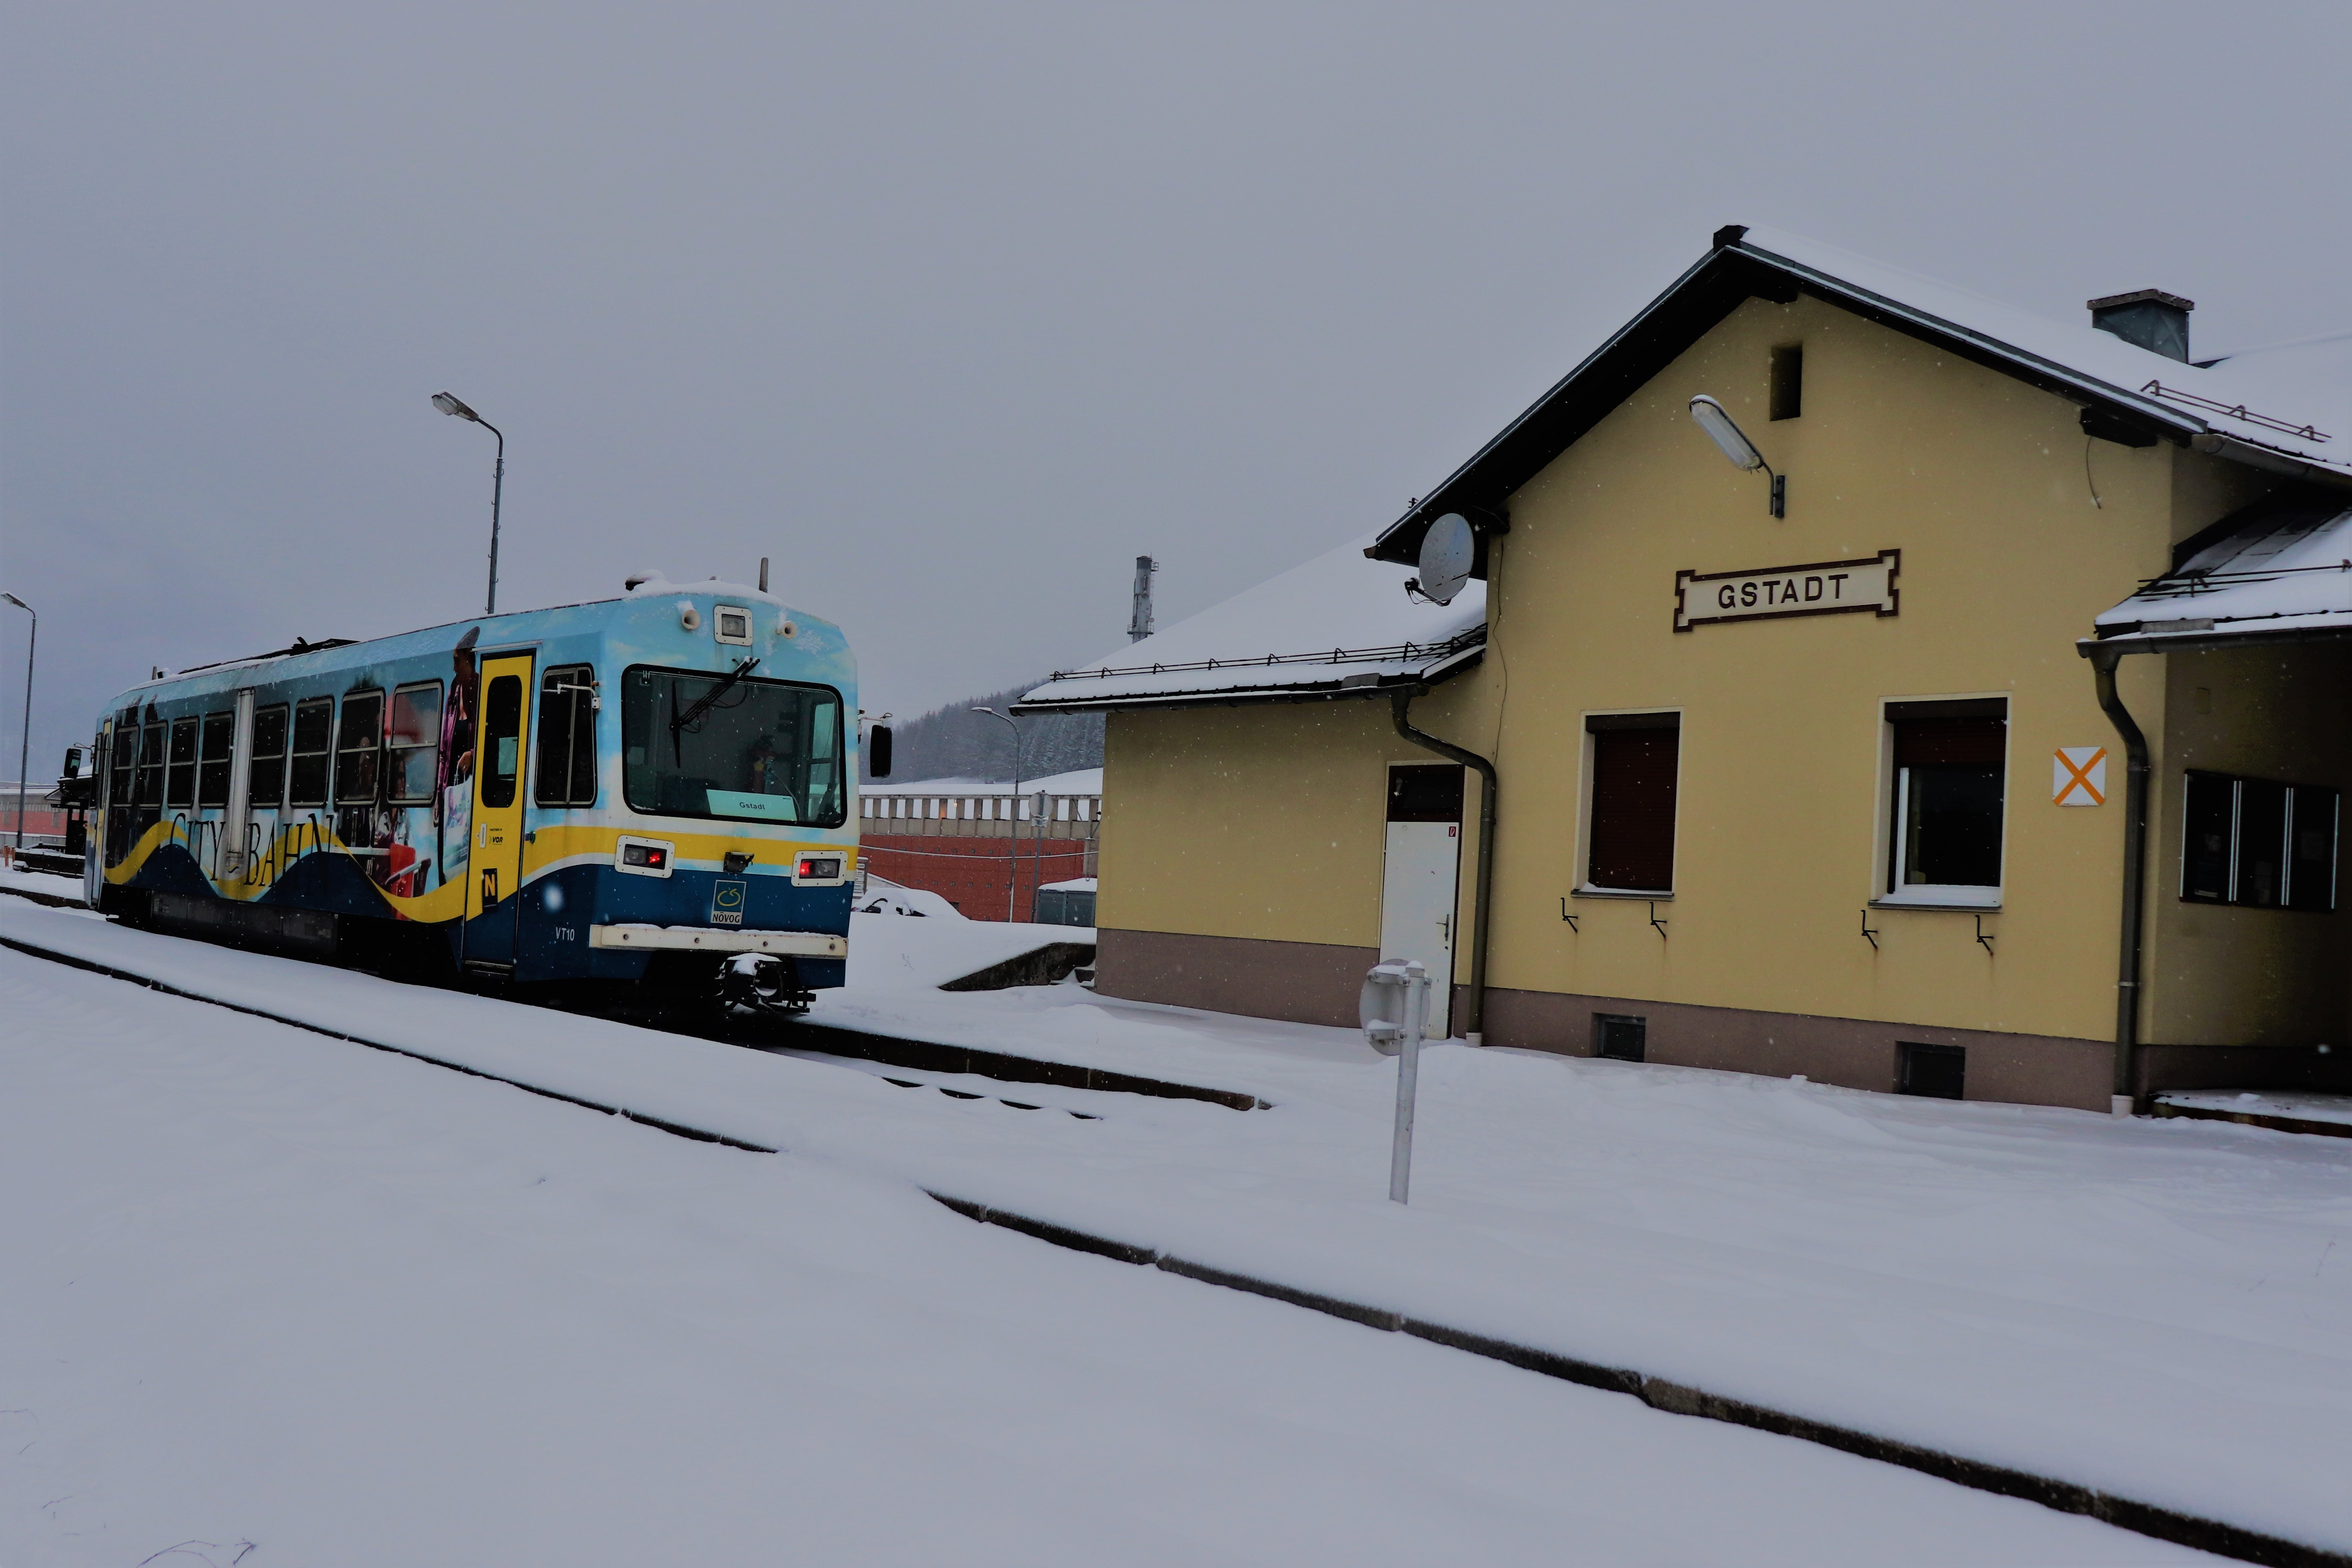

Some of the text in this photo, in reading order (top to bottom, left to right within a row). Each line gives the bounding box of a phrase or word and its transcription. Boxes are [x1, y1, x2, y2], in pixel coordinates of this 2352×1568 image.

[1718, 574, 1848, 609] GSTADT
[739, 802, 765, 810] Gstadt
[244, 813, 333, 899] BAHN
[485, 874, 496, 897] N
[713, 912, 740, 923] NÖVOG
[555, 926, 575, 941] VT10
